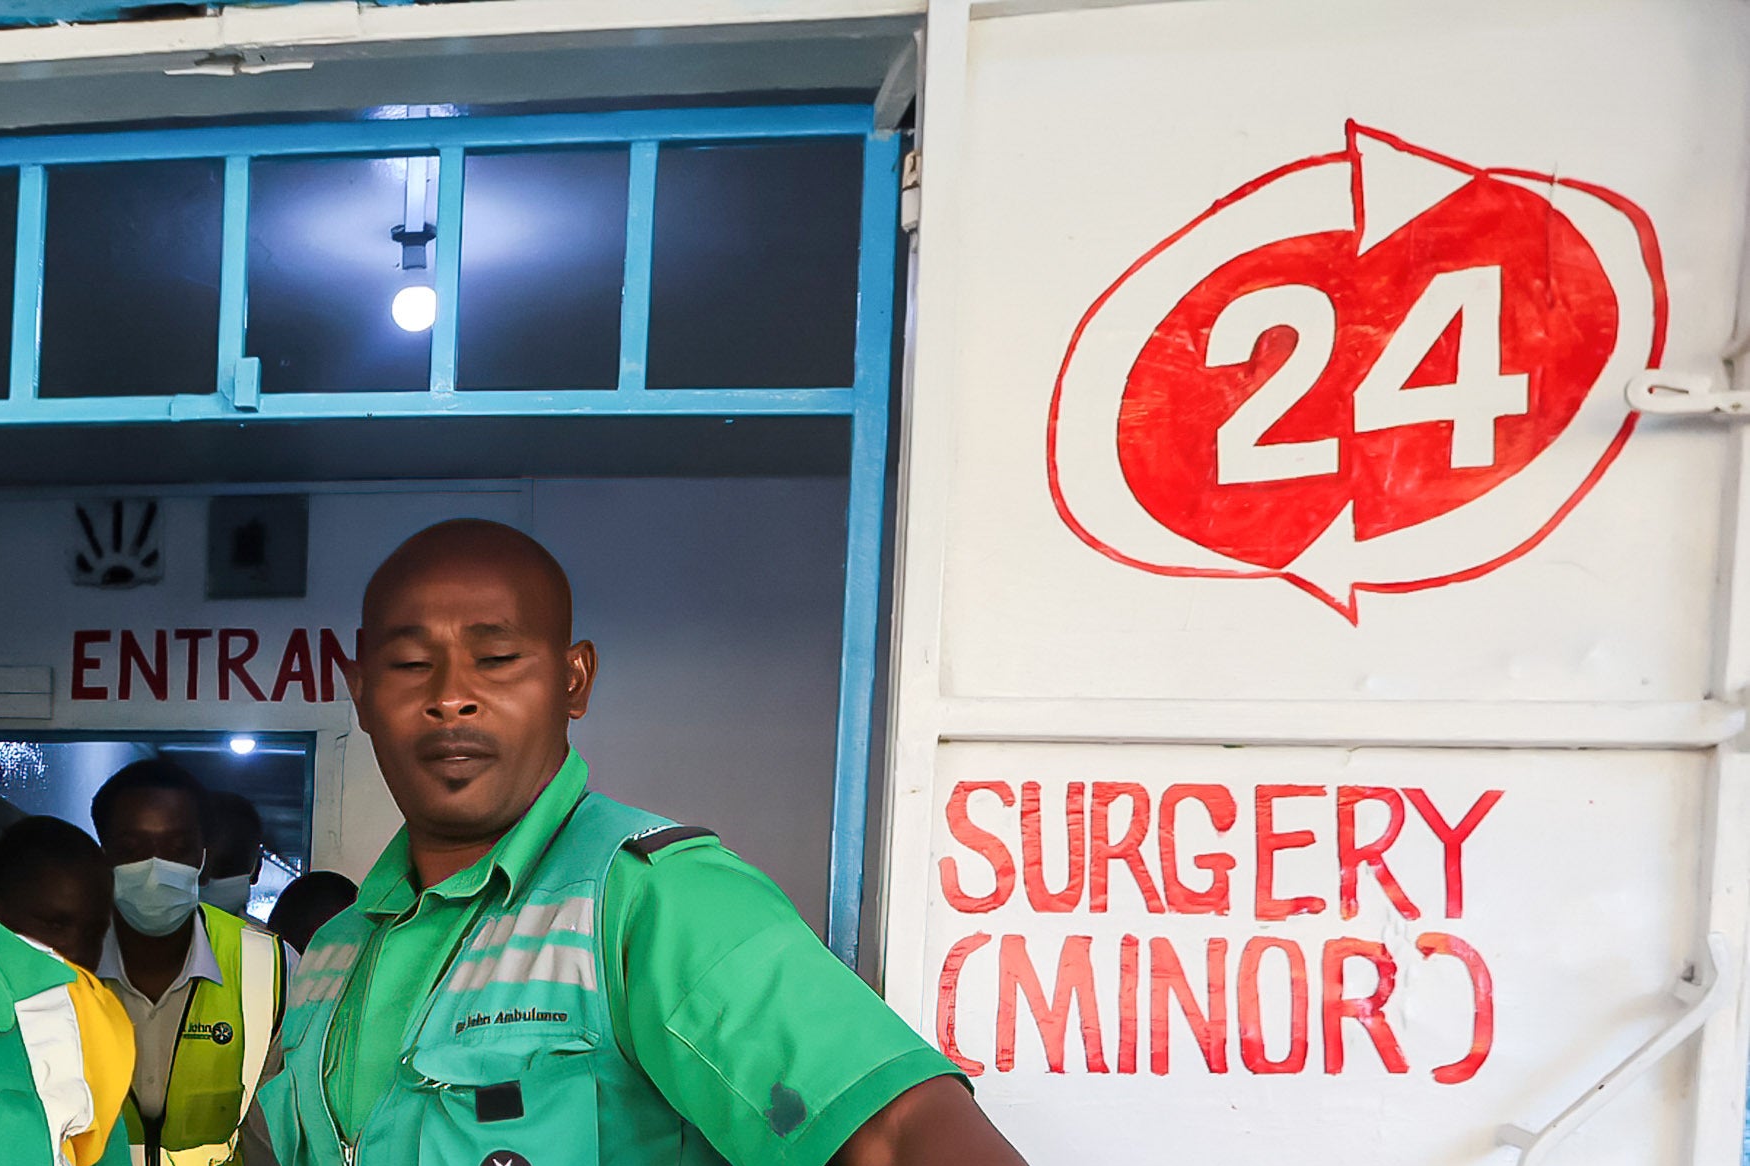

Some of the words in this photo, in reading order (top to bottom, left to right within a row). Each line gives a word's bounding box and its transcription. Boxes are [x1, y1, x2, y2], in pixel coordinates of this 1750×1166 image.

[1205, 265, 1529, 485] 24
[939, 780, 1505, 921] SURGERY
[936, 931, 1493, 1084] (MINOR)
